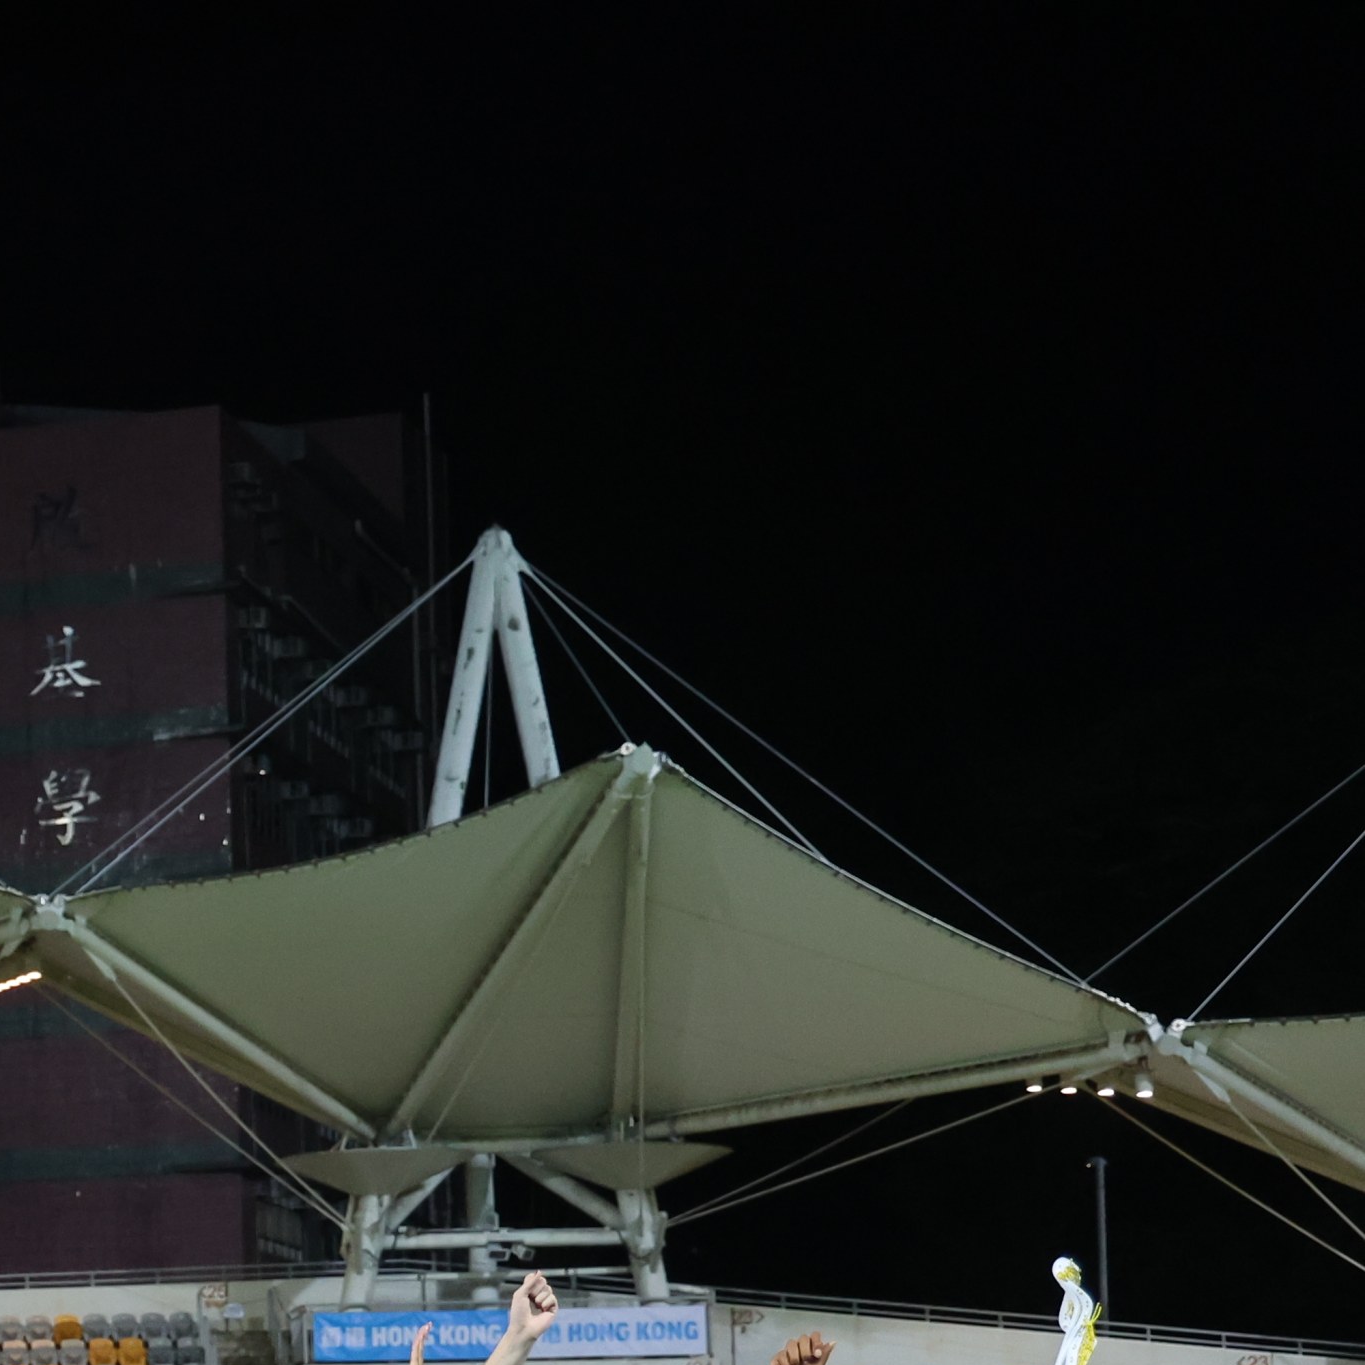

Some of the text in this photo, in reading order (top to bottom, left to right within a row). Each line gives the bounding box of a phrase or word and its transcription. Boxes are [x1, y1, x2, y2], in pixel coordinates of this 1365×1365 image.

[439, 1324, 502, 1346] KONG
[567, 1321, 630, 1343] HONG
[636, 1319, 699, 1341] KONG
